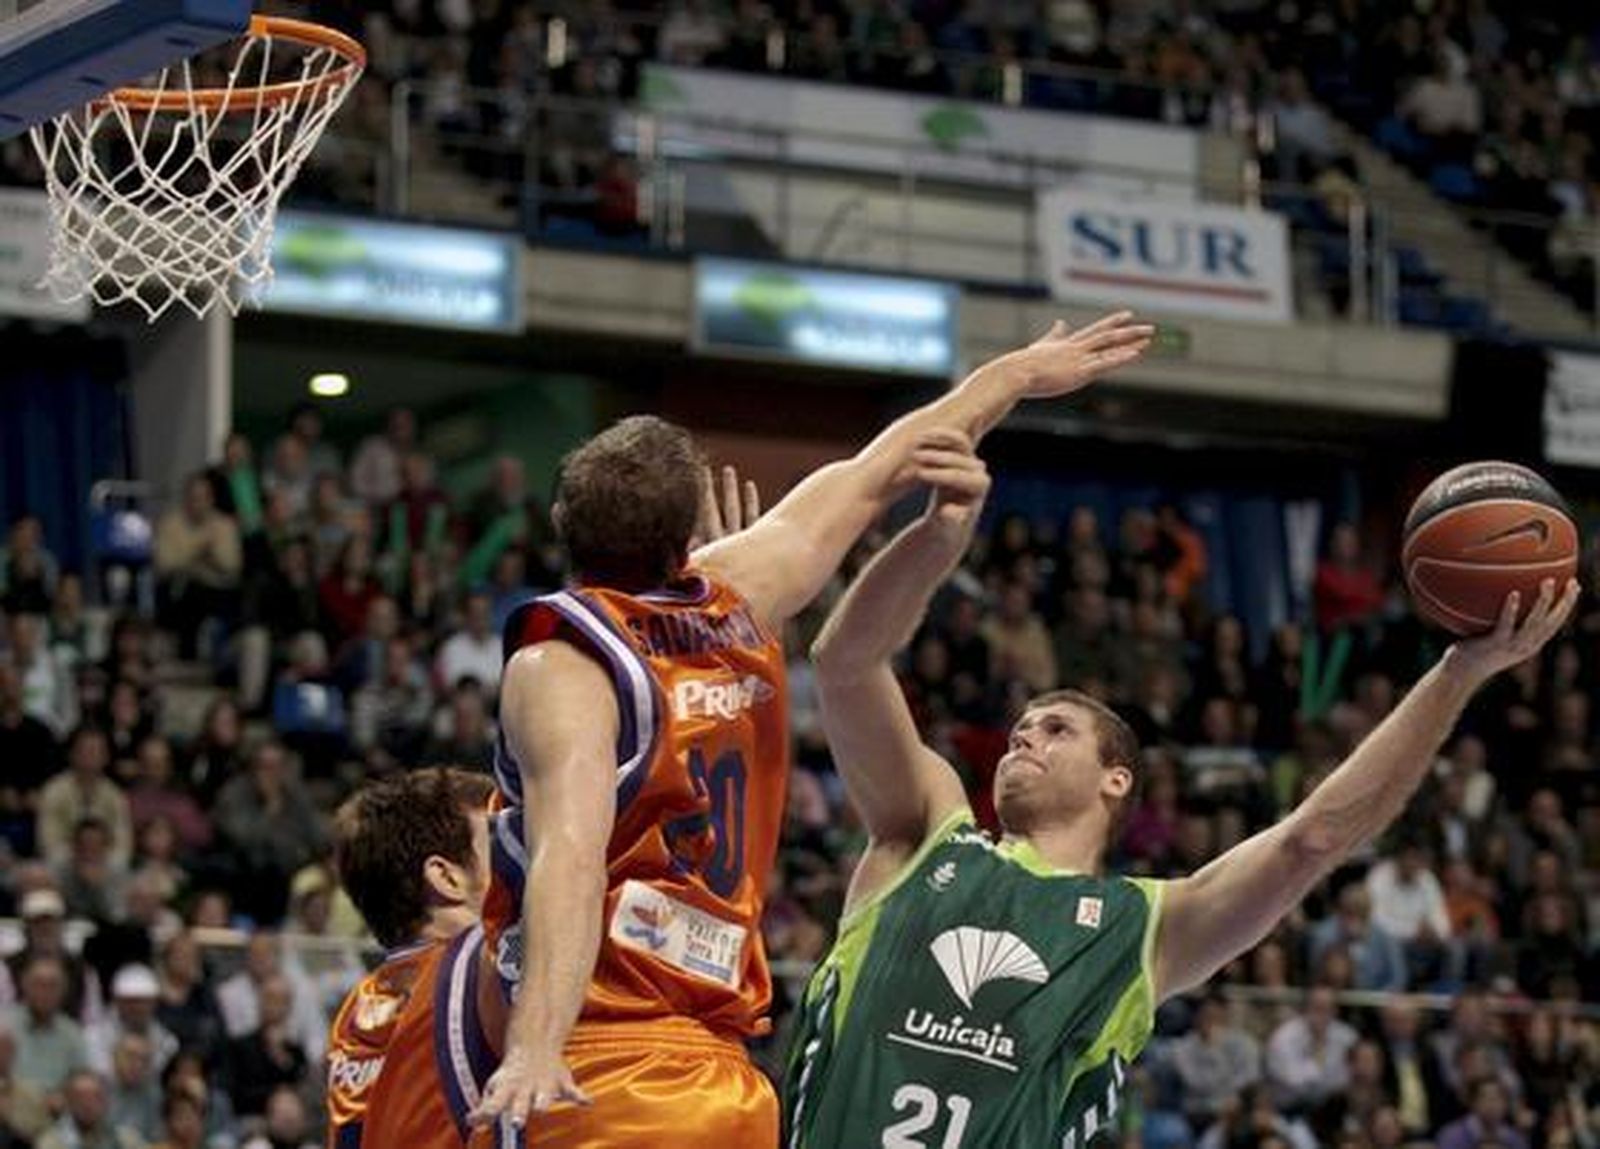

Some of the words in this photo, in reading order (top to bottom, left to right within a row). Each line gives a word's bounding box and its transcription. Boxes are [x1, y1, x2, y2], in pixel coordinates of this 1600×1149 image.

[1071, 213, 1255, 278] SUR
[904, 1008, 1014, 1057] Unicaja
[882, 1083, 972, 1149] 21
